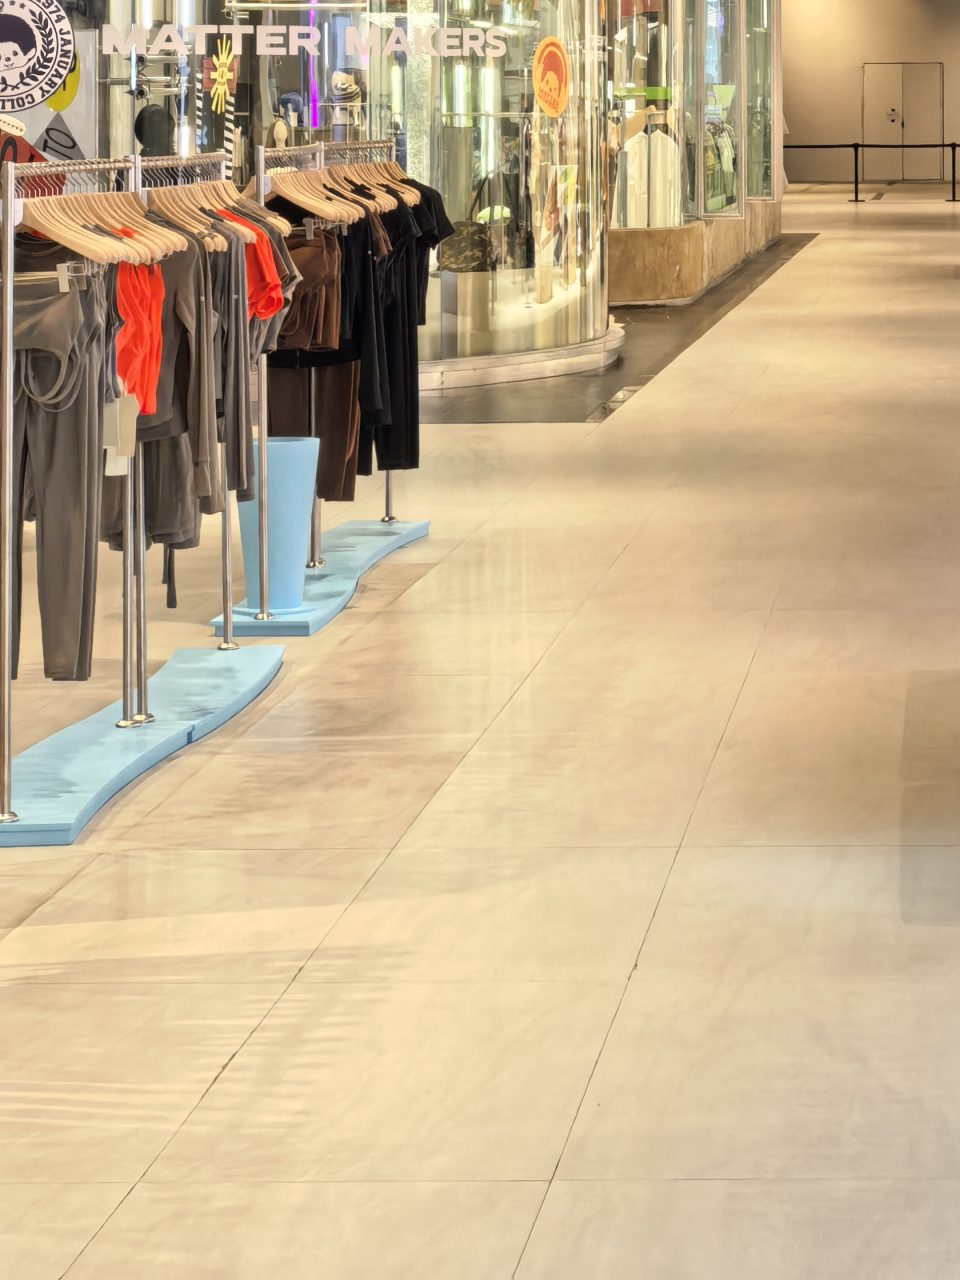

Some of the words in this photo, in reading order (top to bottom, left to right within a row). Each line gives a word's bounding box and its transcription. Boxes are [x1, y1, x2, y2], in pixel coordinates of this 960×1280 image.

[39, 27, 72, 99] JANUARY
[101, 23, 321, 56] MATTER
[345, 25, 508, 57] MAKERS
